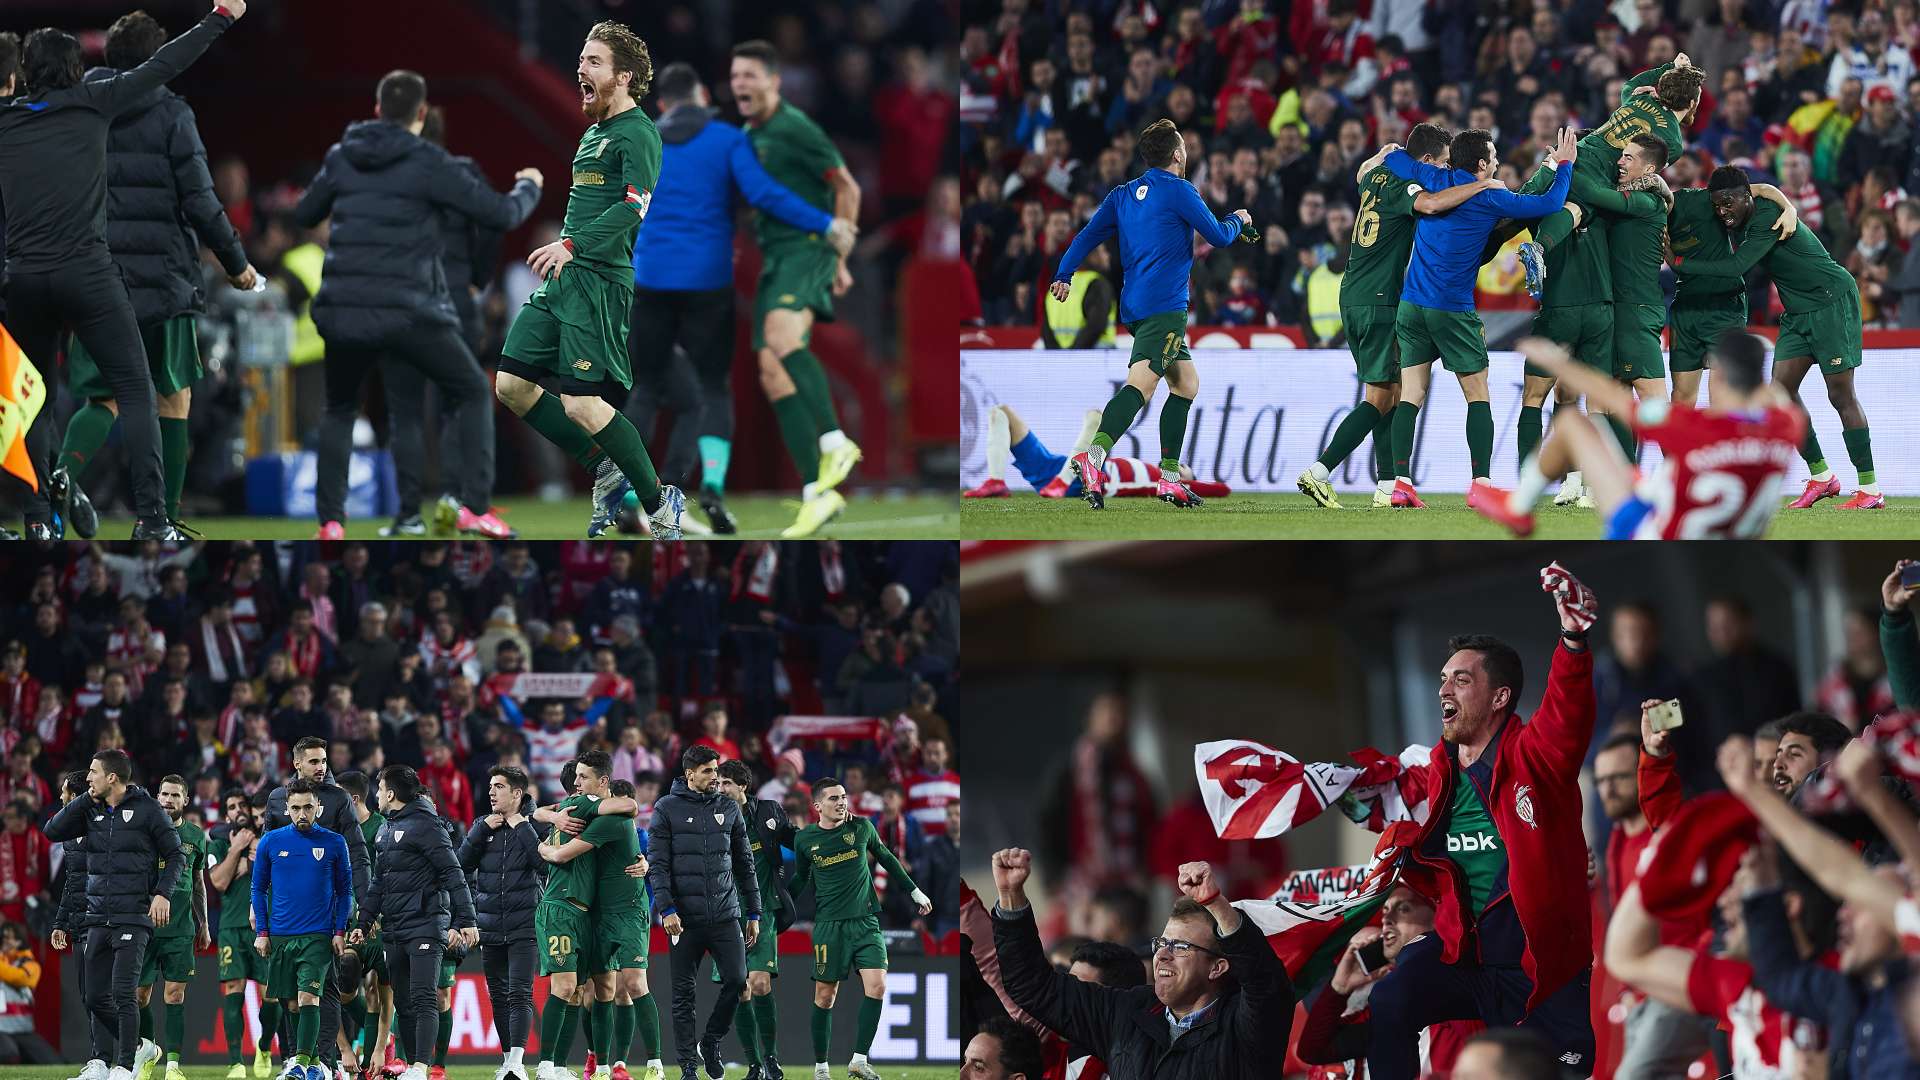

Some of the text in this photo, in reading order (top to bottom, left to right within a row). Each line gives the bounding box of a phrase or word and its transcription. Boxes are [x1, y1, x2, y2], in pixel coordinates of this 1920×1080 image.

[1351, 188, 1382, 248] 16
[1318, 371, 1431, 485] dl
[1446, 831, 1498, 852] bbk
[1281, 866, 1369, 896] ANADA
[548, 935, 572, 956] 20
[814, 943, 828, 964] 11
